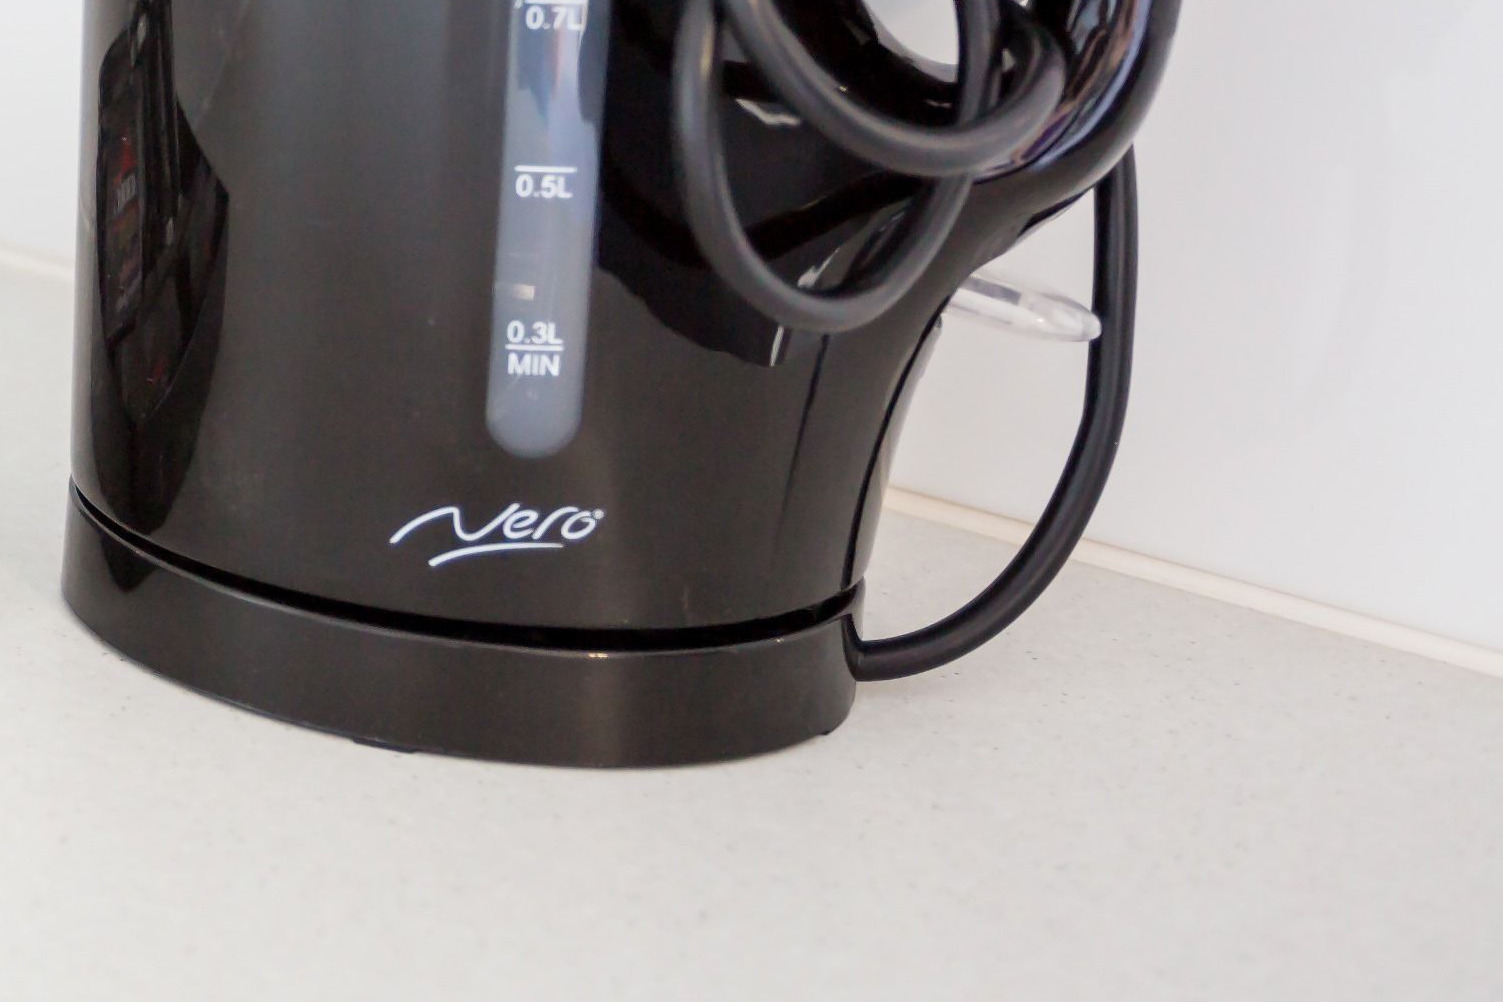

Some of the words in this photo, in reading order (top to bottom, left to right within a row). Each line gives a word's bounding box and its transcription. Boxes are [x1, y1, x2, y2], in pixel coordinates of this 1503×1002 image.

[525, 5, 584, 30] 0.7L
[515, 173, 573, 199] 0.5L
[507, 320, 563, 345] 0.3L
[507, 353, 560, 377] MIN
[389, 502, 596, 544] Nero
